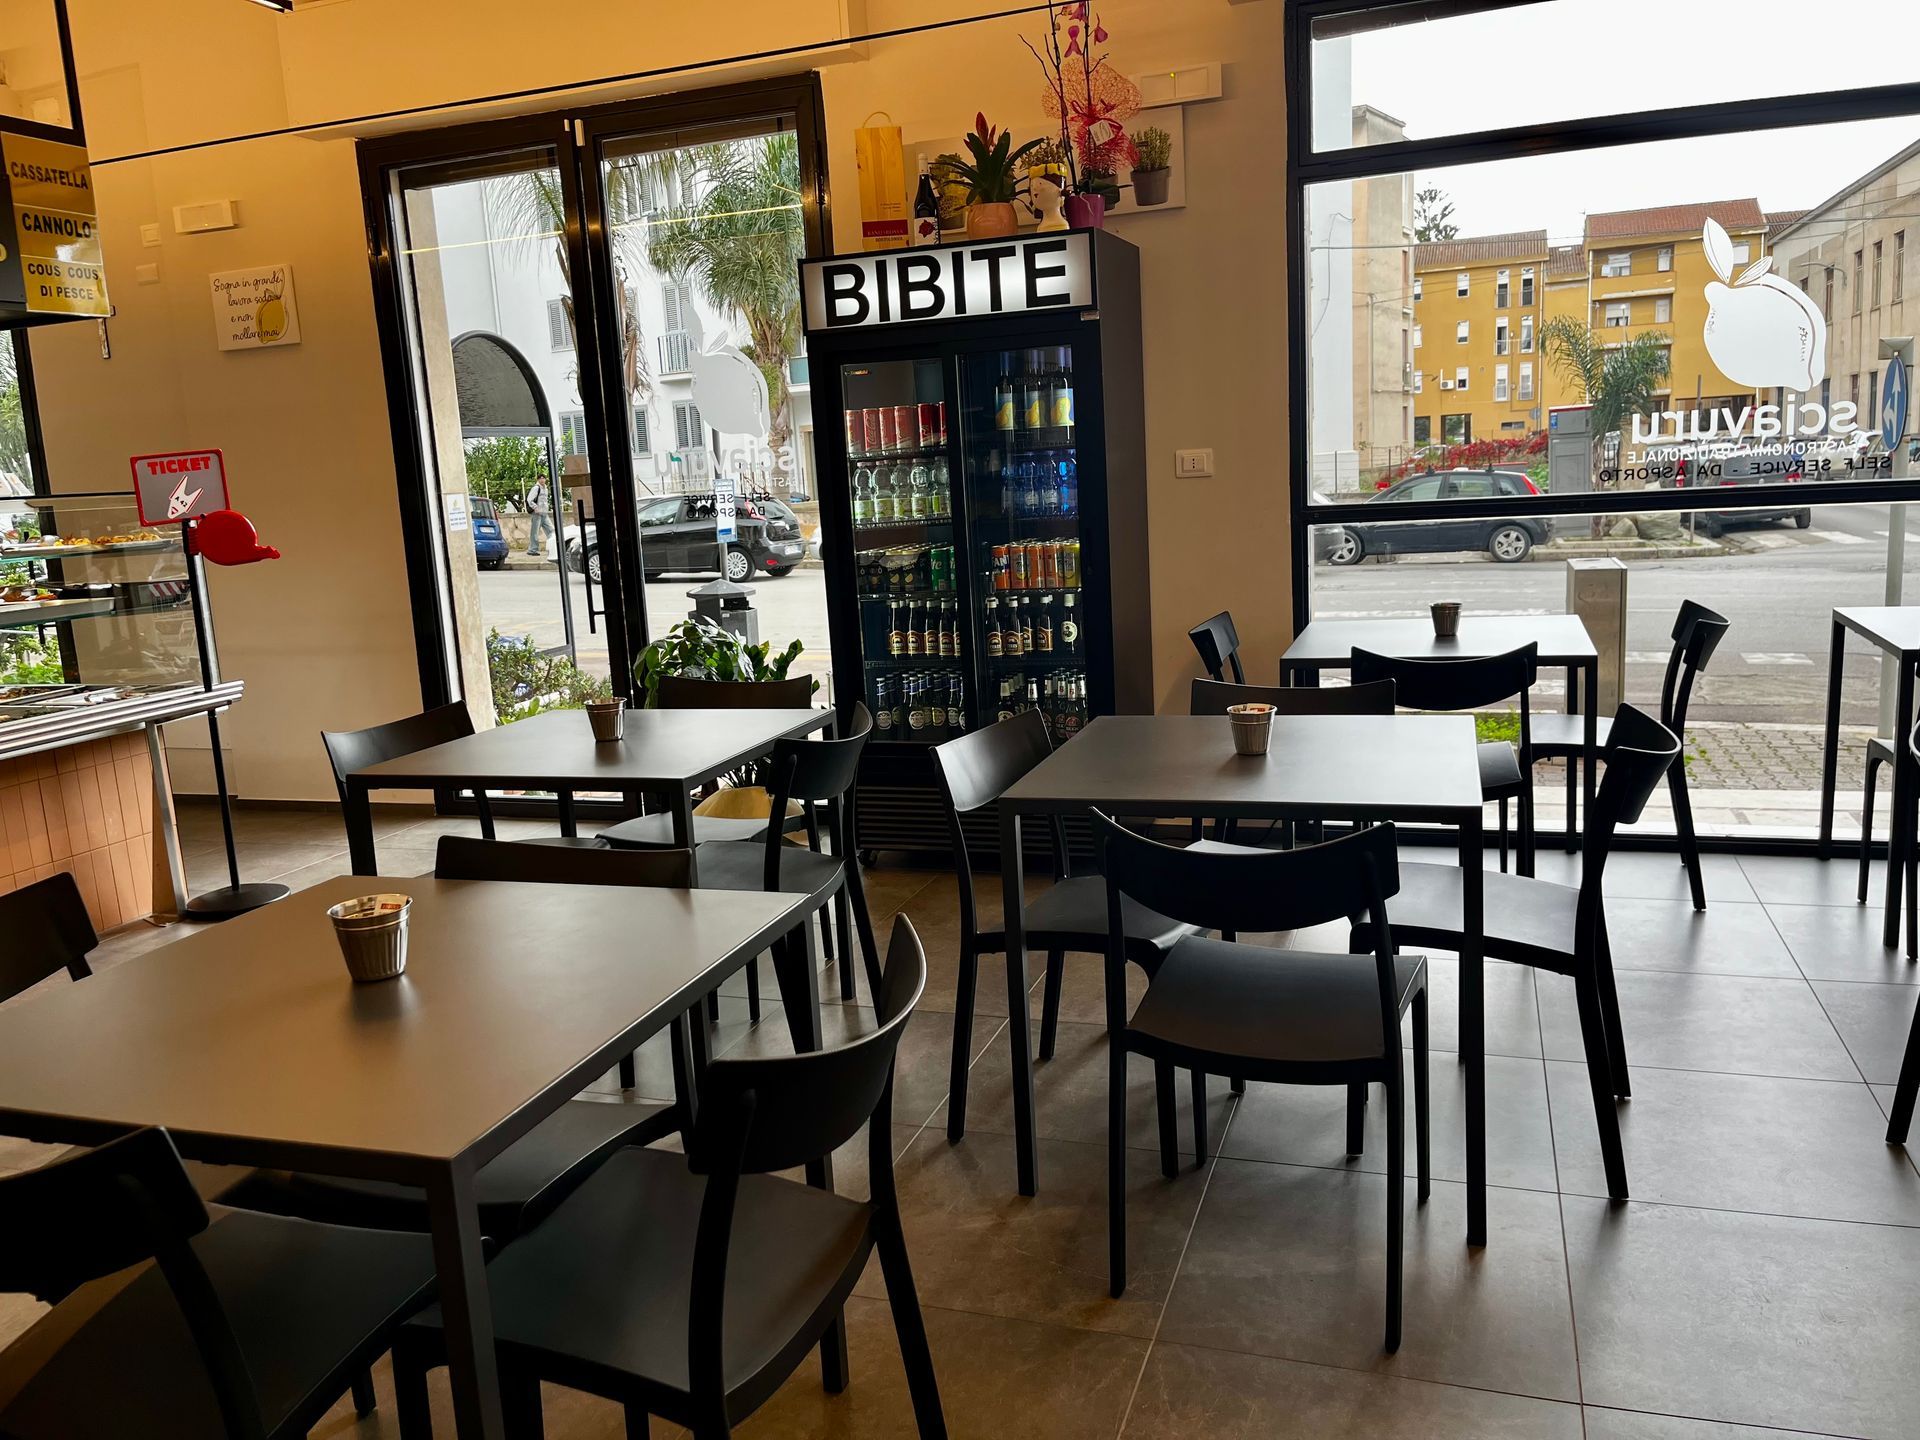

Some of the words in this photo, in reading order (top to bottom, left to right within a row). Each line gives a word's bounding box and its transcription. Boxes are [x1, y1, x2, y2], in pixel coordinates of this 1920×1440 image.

[11, 162, 89, 190] CASSATELLA
[22, 212, 92, 239] CANNOLO
[27, 263, 62, 278] COUS
[68, 267, 99, 281] COUS
[213, 278, 241, 294] Sogna
[242, 277, 251, 288] in
[822, 239, 1071, 327] BIBITE
[40, 284, 53, 297] DI
[56, 286, 95, 300] PESCE
[228, 294, 253, 307] lavora
[238, 313, 254, 323] non
[232, 327, 262, 341] mollare
[263, 325, 281, 337] mai
[148, 456, 210, 475] TICKET
